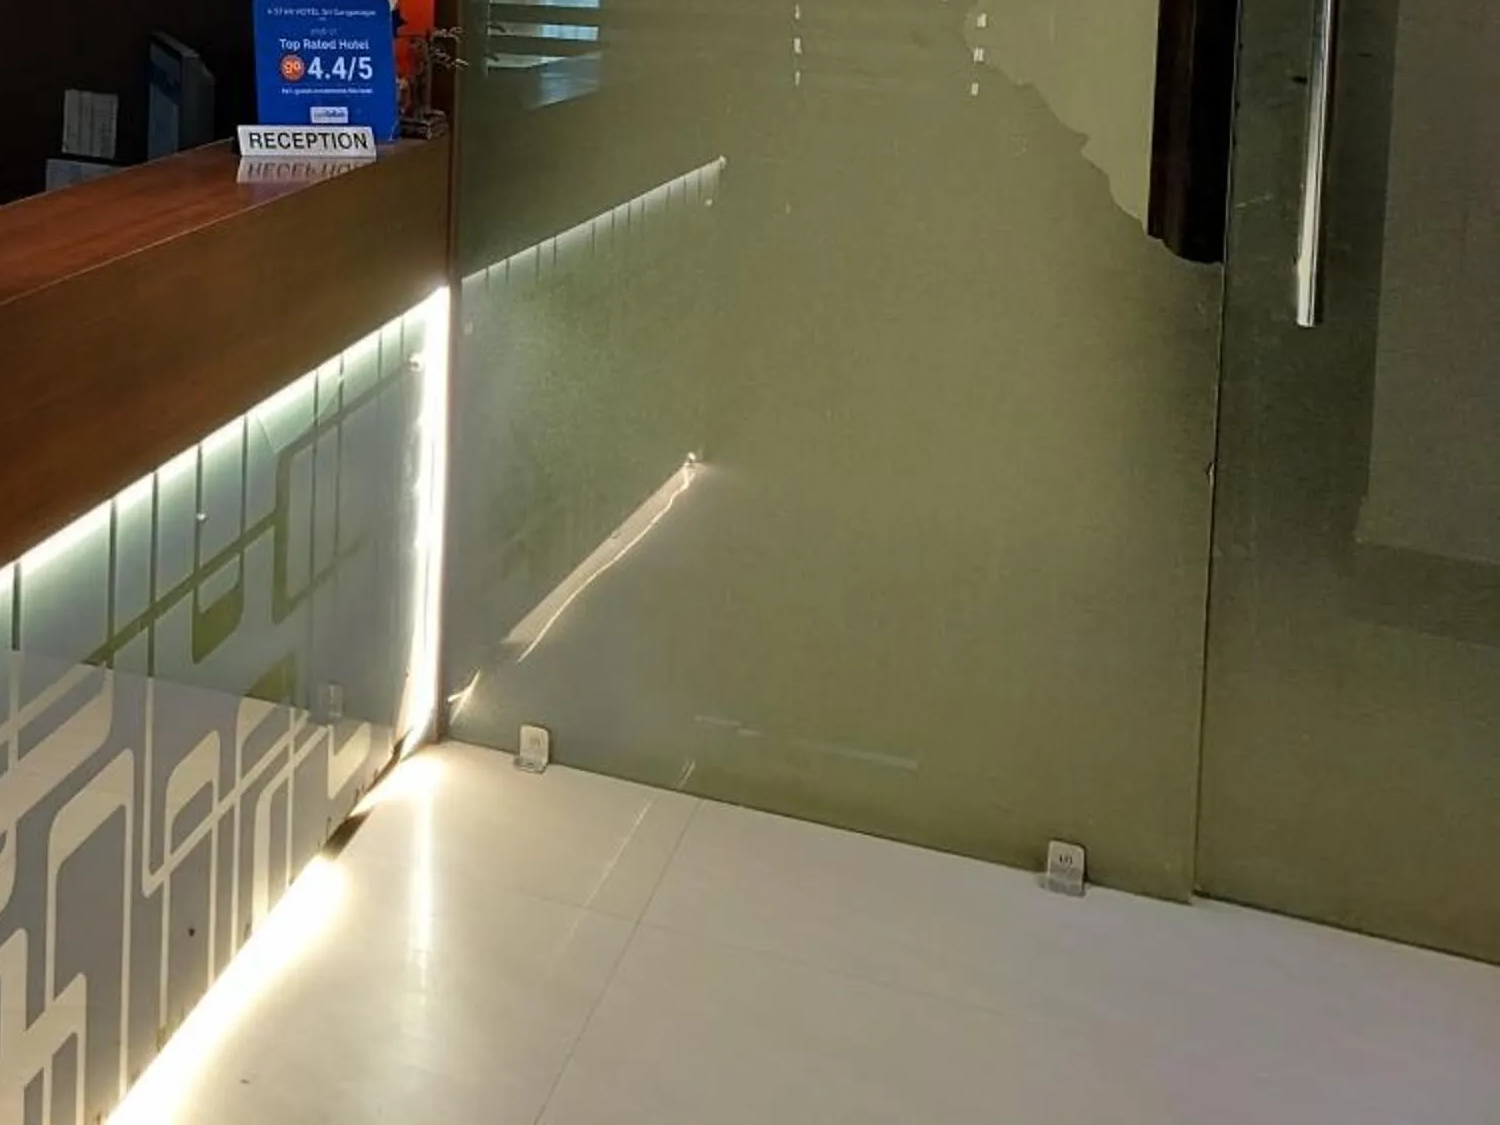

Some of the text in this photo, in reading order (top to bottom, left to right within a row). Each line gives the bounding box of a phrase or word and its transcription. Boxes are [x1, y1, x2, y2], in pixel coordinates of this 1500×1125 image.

[279, 38, 370, 51] Top Rated Hotel
[307, 56, 373, 81] 4.4/5
[249, 132, 368, 150] RECEPTION
